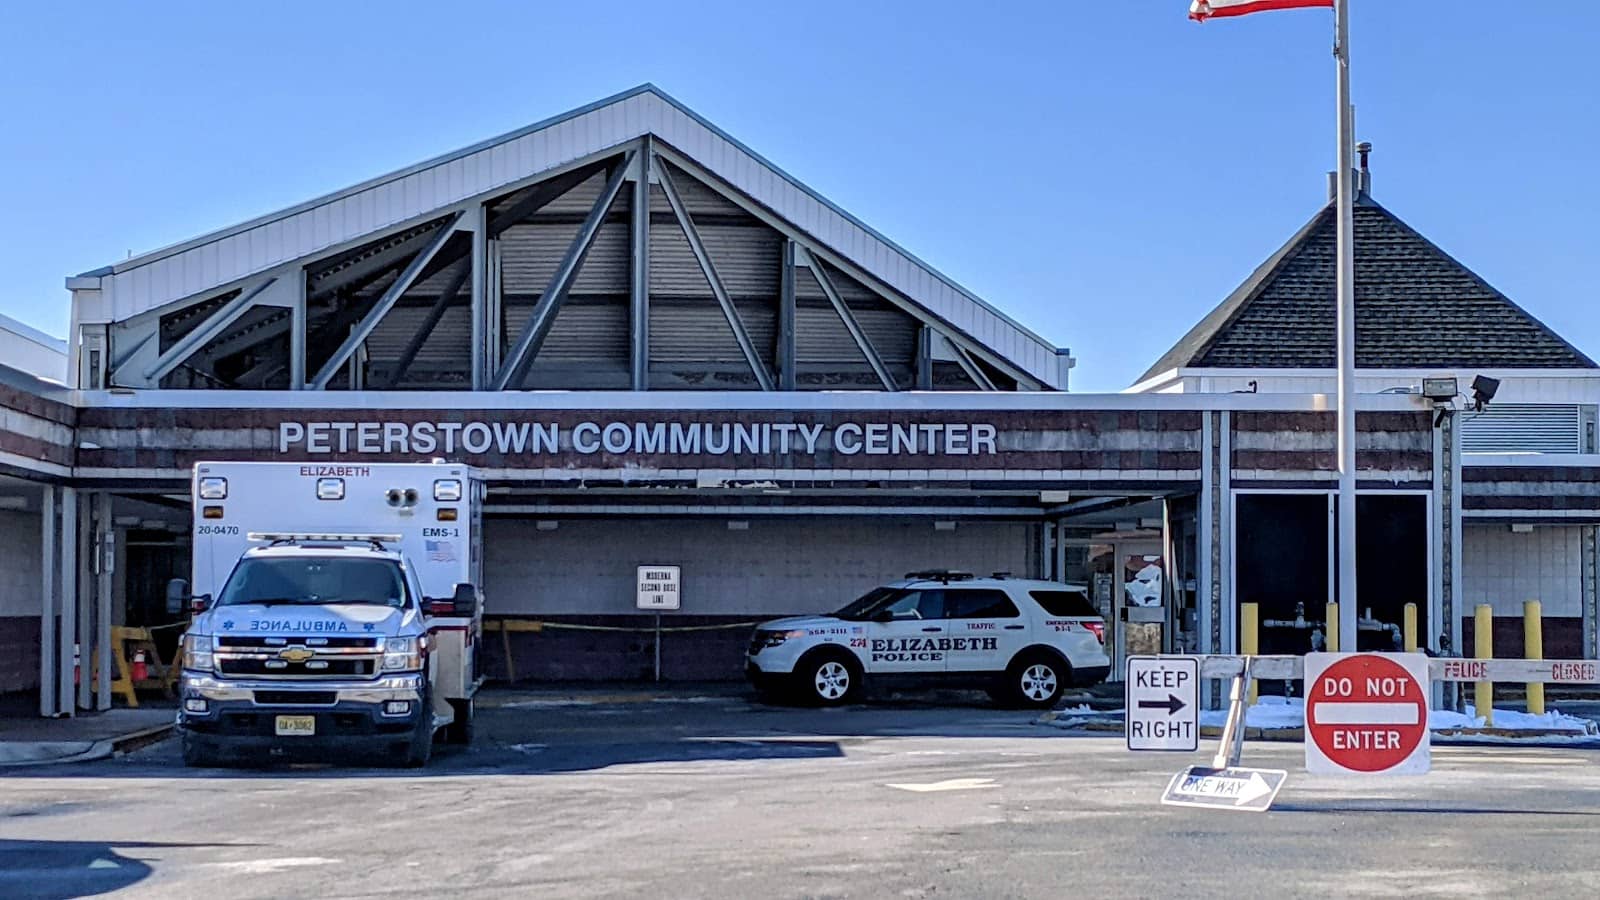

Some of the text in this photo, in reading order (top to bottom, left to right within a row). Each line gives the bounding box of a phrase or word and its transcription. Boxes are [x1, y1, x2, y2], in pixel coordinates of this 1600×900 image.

[278, 422, 997, 455] PETERSTOWN COMMUNITY CENTER
[300, 467, 370, 476] ELIZABETH
[198, 526, 239, 535] 20-0470
[422, 528, 459, 537] EMS-1
[641, 583, 661, 592] SECOND
[652, 595, 664, 604] LINE
[871, 637, 998, 652] ELIZABETH
[872, 652, 943, 662] POLICE
[1136, 670, 1189, 689] KEEP
[1444, 661, 1595, 681] POLICE CLOSED
[1324, 677, 1409, 697] DO NOT
[1132, 721, 1193, 740] RIGHT
[1333, 730, 1401, 749] ENTER
[1181, 776, 1246, 795] ONE WAY
